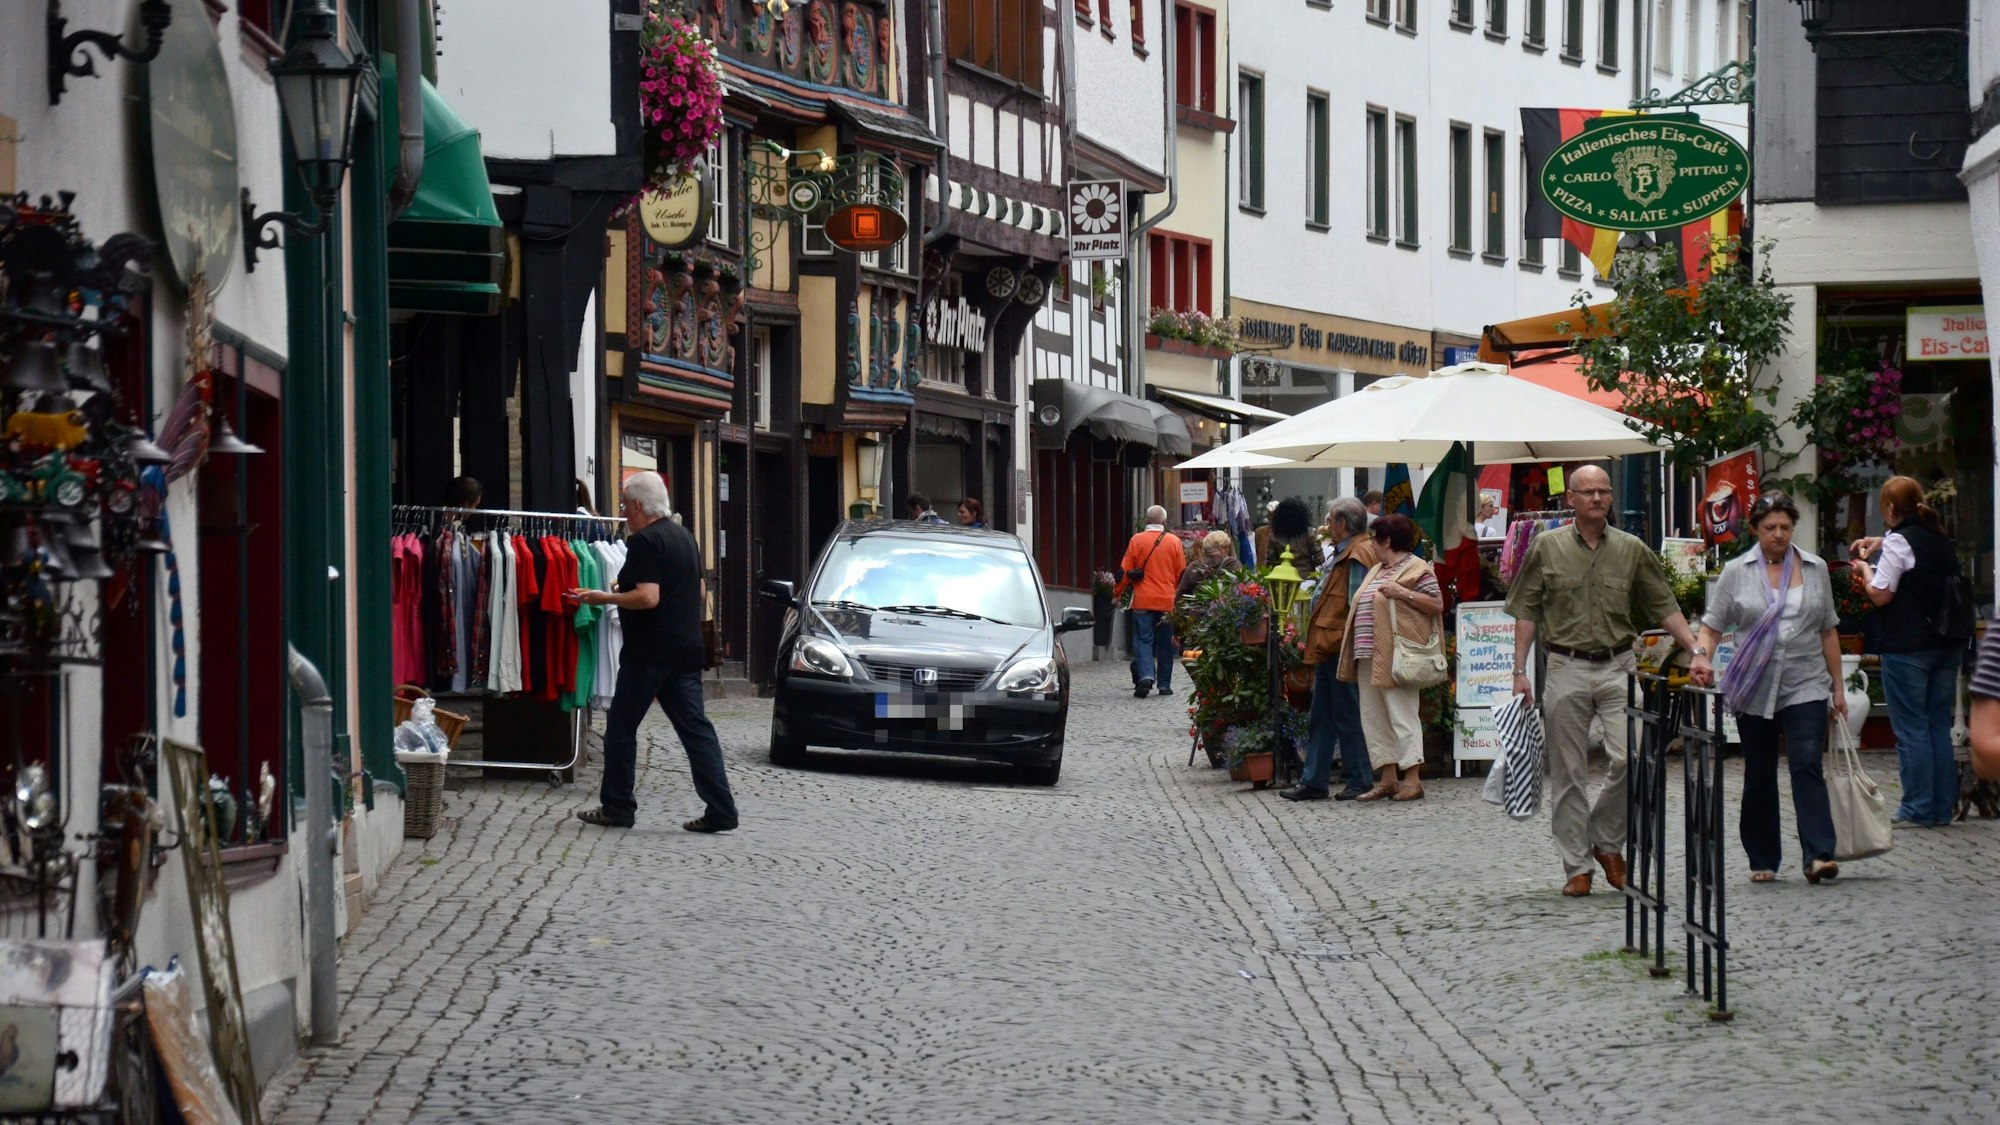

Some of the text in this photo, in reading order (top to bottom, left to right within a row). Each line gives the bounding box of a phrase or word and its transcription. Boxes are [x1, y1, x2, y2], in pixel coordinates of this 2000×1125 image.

[1560, 127, 1728, 166] Italienisches Eis-Café
[1563, 165, 1728, 183] CARLO PITTAU
[1553, 177, 1740, 222] PIZZA SALATE SUPPEN
[1092, 239, 1119, 250] Platz
[956, 296, 986, 353] Platz
[1493, 653, 1515, 661] LATT
